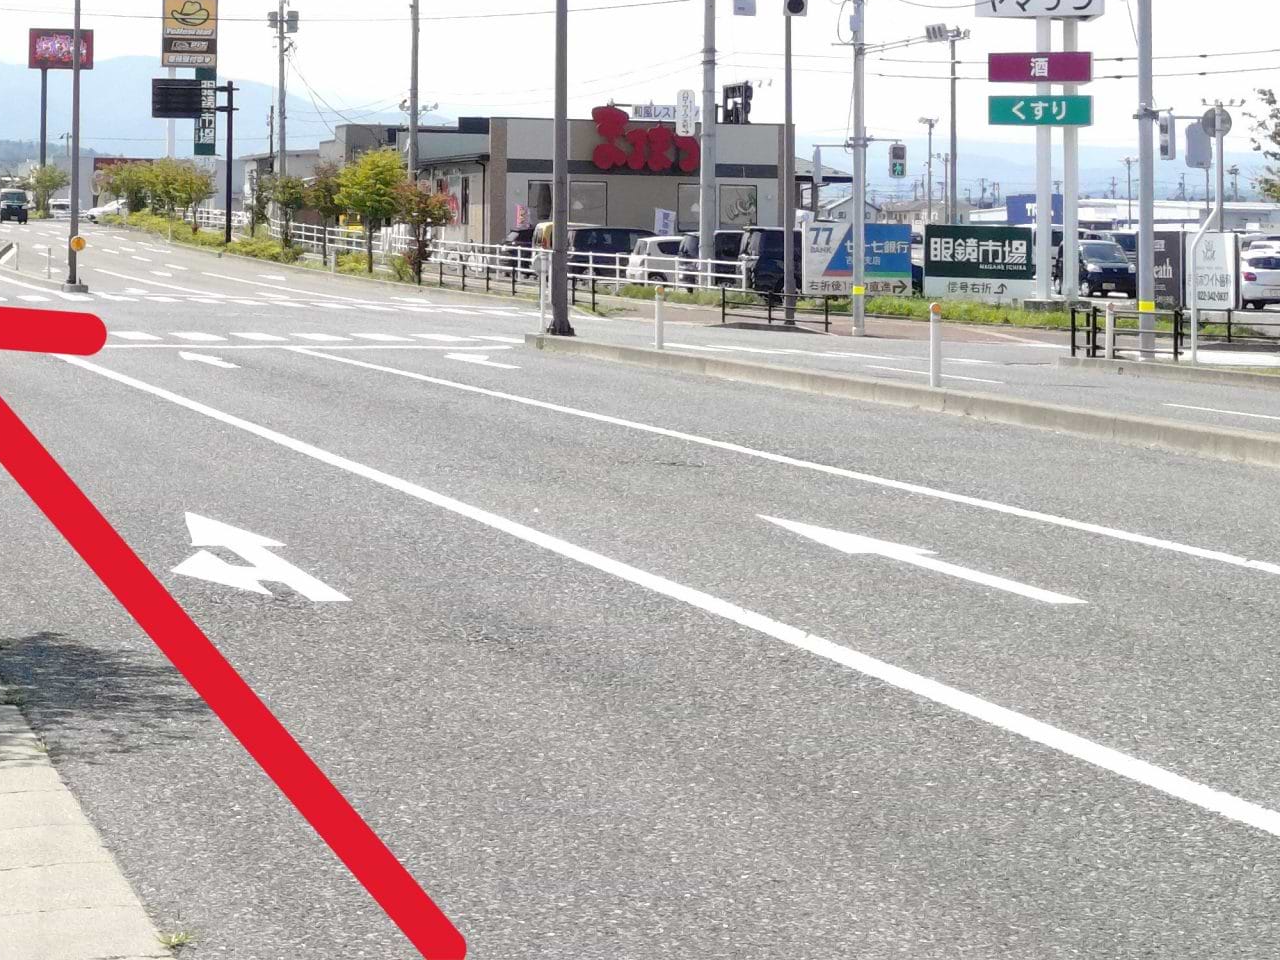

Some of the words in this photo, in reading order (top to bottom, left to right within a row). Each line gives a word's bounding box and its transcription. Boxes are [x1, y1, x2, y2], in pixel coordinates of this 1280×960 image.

[1030, 57, 1049, 77] 酒
[1011, 100, 1067, 120] くすり
[809, 227, 834, 246] 77
[844, 240, 910, 254] 七七銀行
[929, 237, 1027, 264] 眼鏡市場
